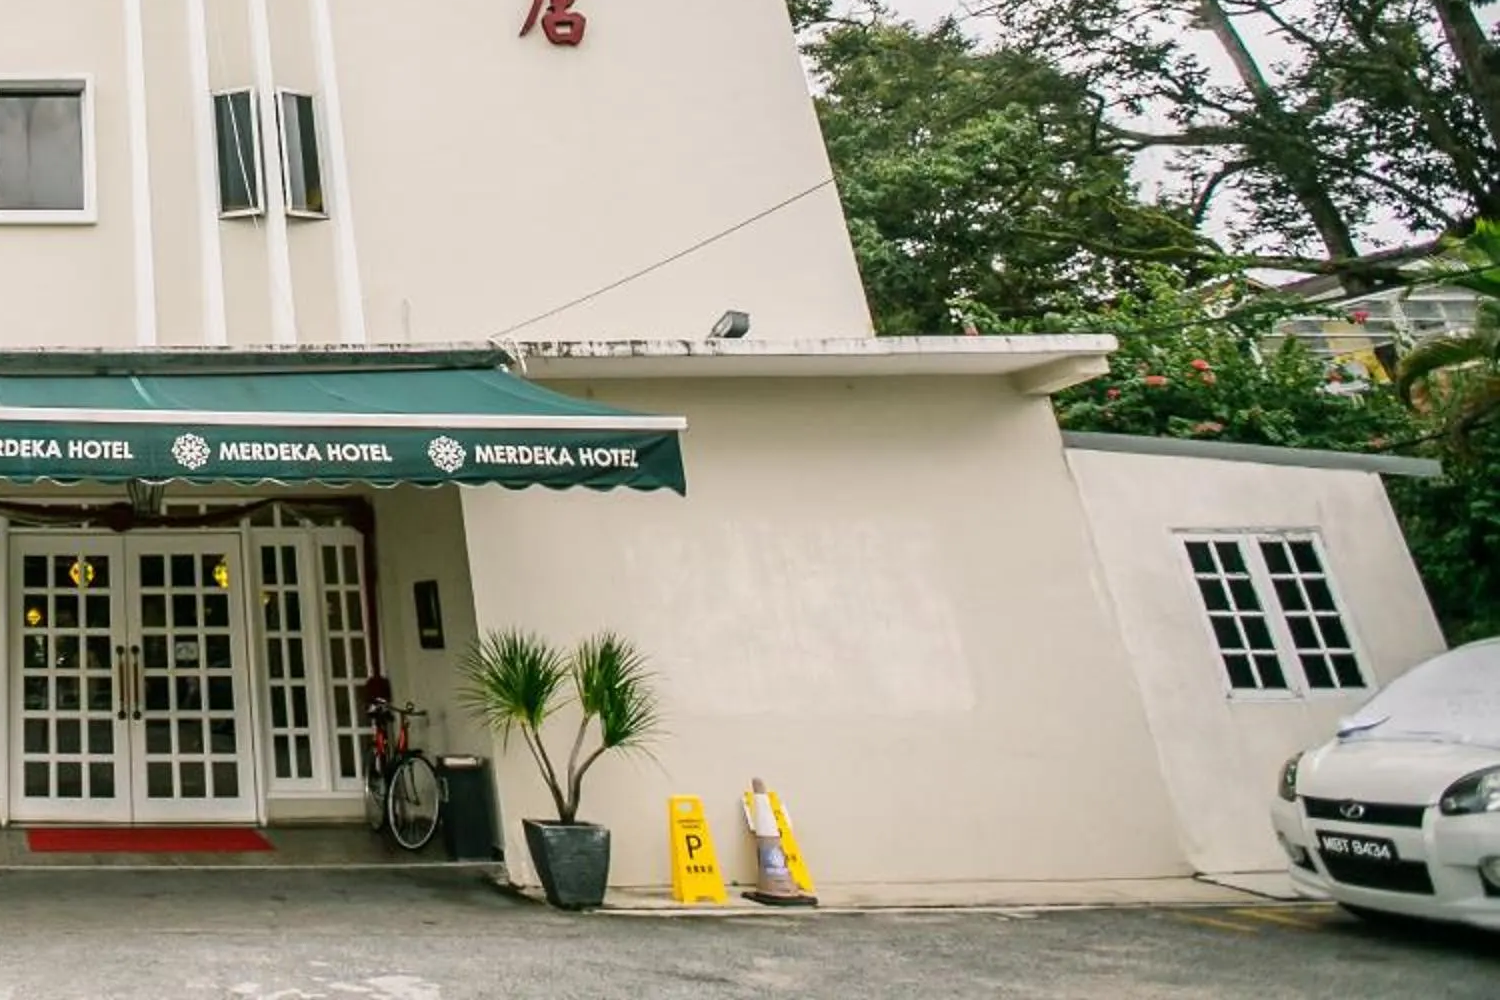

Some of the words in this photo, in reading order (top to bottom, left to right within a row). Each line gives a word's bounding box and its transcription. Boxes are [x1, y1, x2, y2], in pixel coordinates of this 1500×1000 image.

[67, 440, 134, 460] HOTEL
[218, 441, 323, 462] MERDEKA
[326, 443, 393, 463] HOTEL
[474, 444, 576, 467] MERDEKA
[578, 447, 640, 468] HOTEL
[685, 834, 703, 860] P
